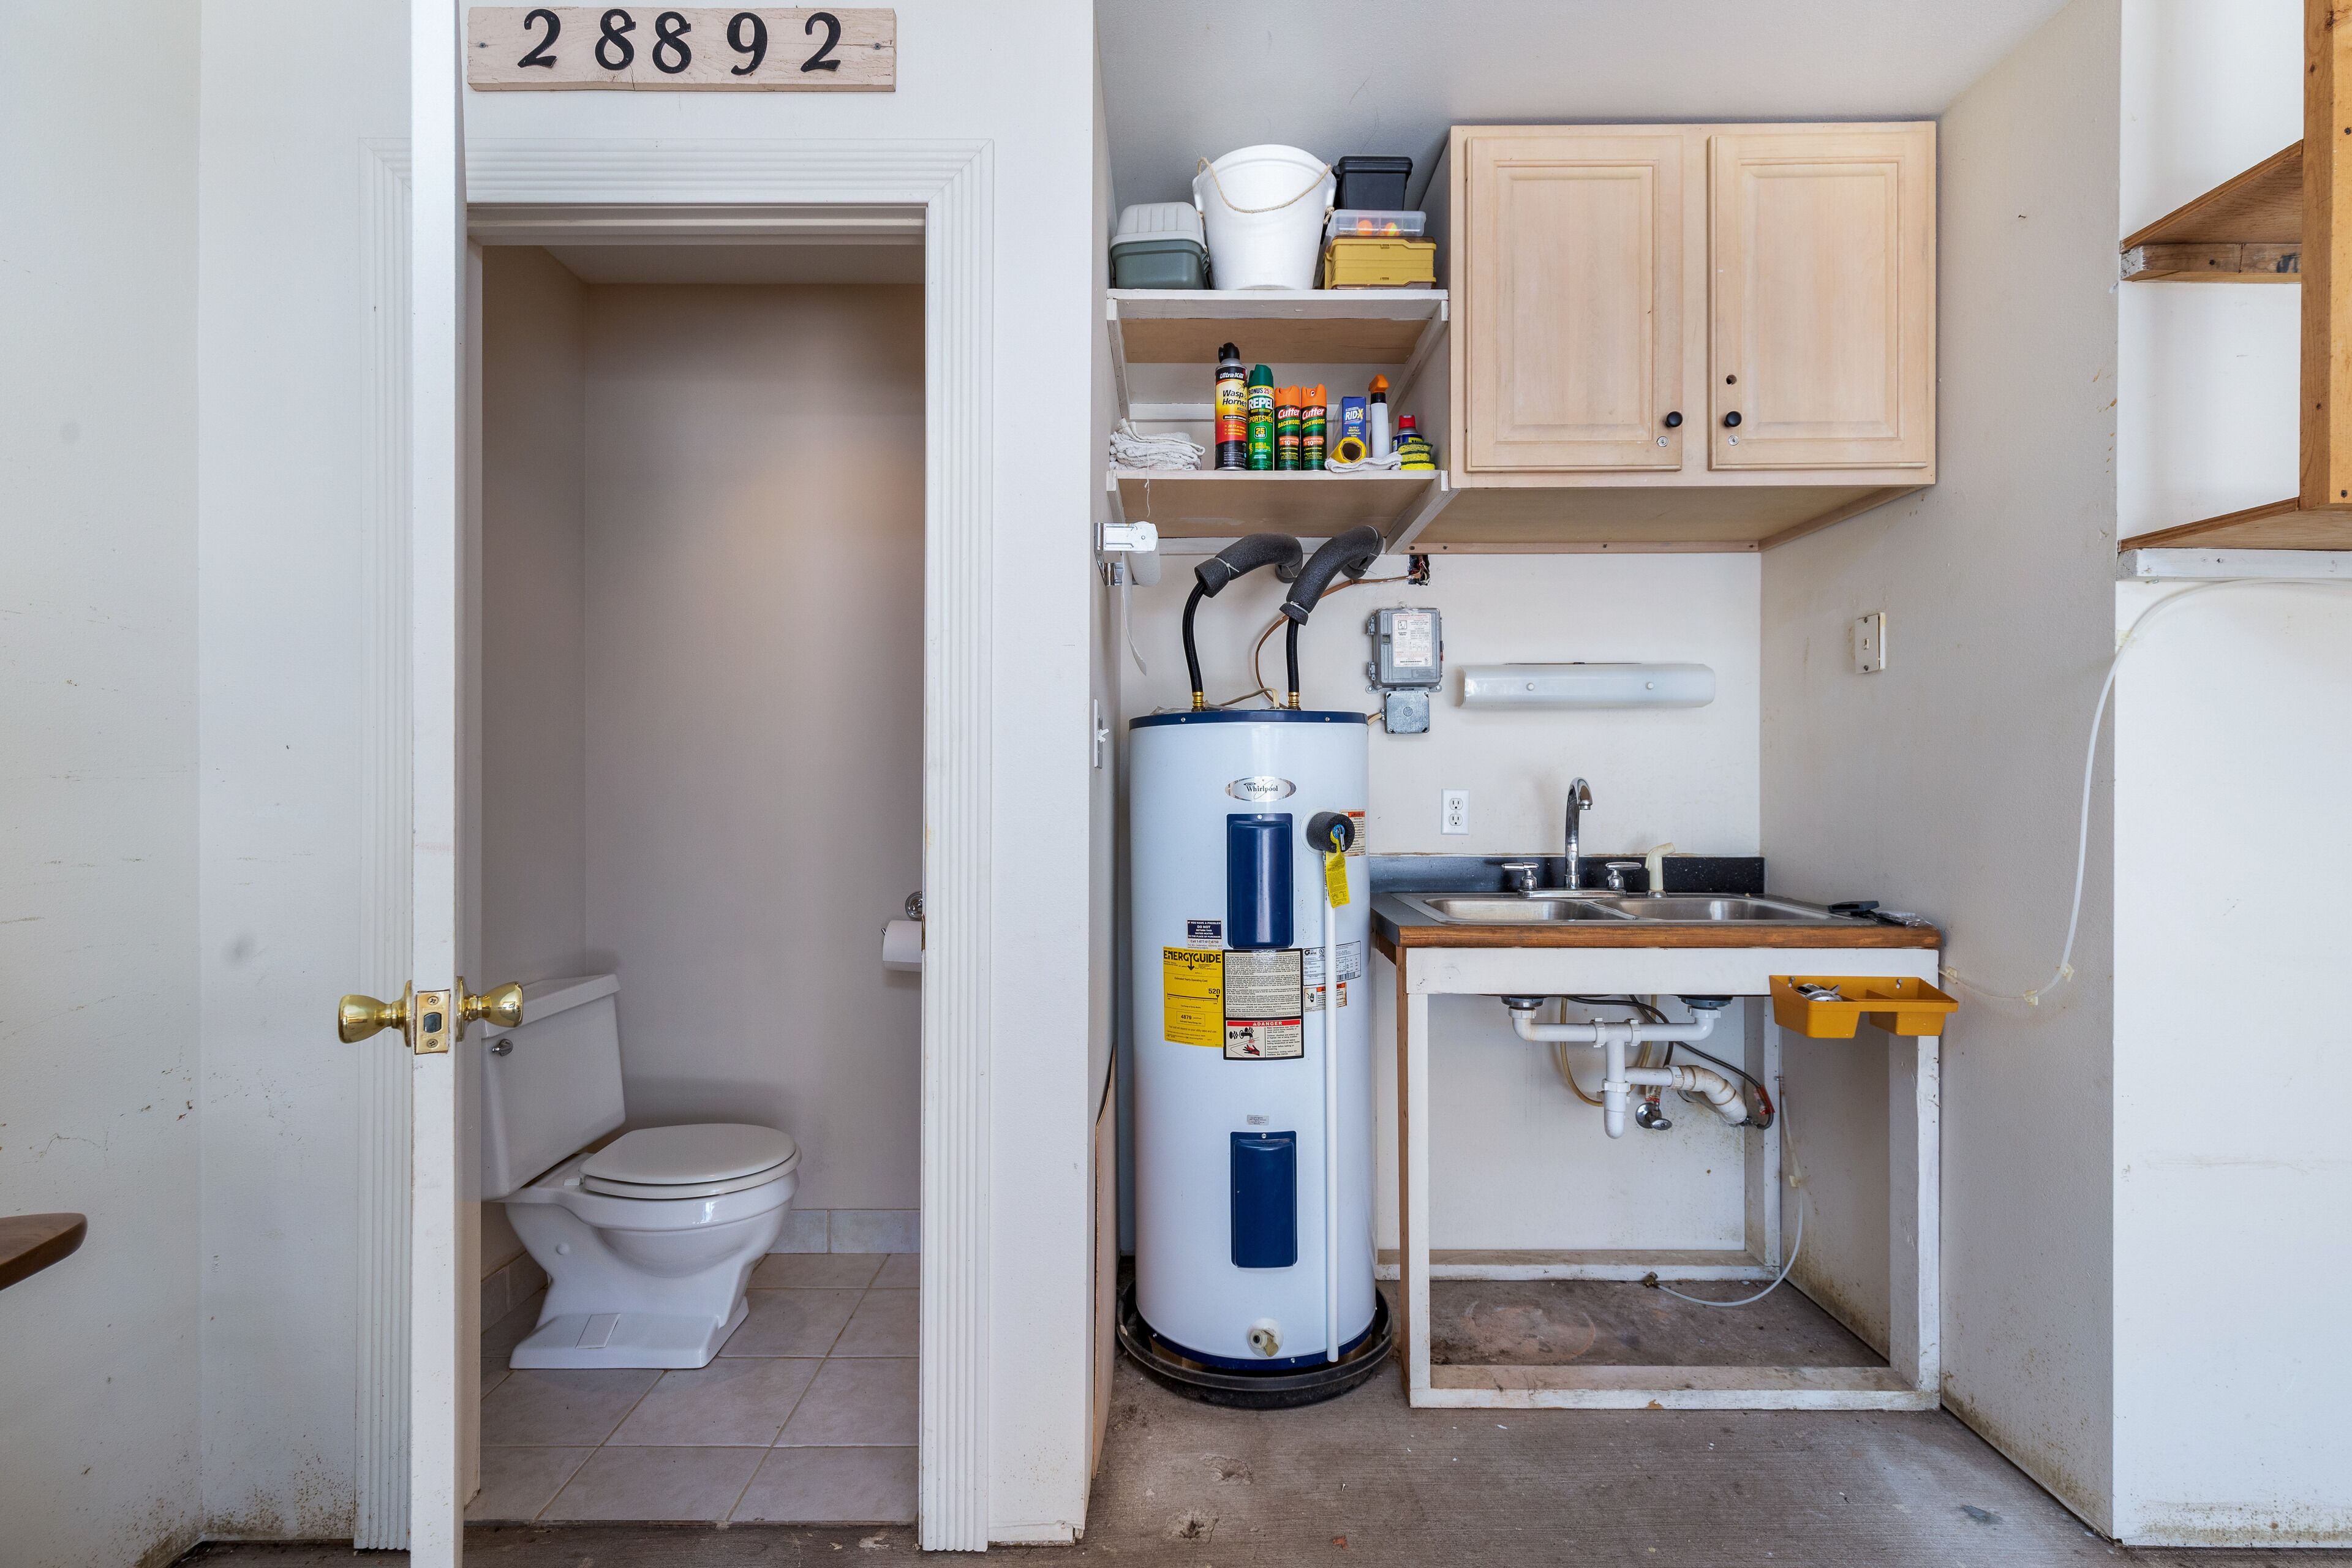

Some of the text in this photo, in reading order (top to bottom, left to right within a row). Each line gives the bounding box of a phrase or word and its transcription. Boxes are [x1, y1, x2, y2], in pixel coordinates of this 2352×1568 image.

[518, 9, 842, 75] 28892
[1223, 390, 1244, 399] Wasp
[1222, 398, 1247, 407] Hornet
[1248, 398, 1273, 410] REPEL
[1278, 407, 1300, 419] Cutter
[1302, 408, 1325, 420] Cutter
[1345, 409, 1363, 421] RID-X
[1302, 419, 1325, 429] BACKWOODS
[1164, 950, 1221, 963] ENERGYGUIDE
